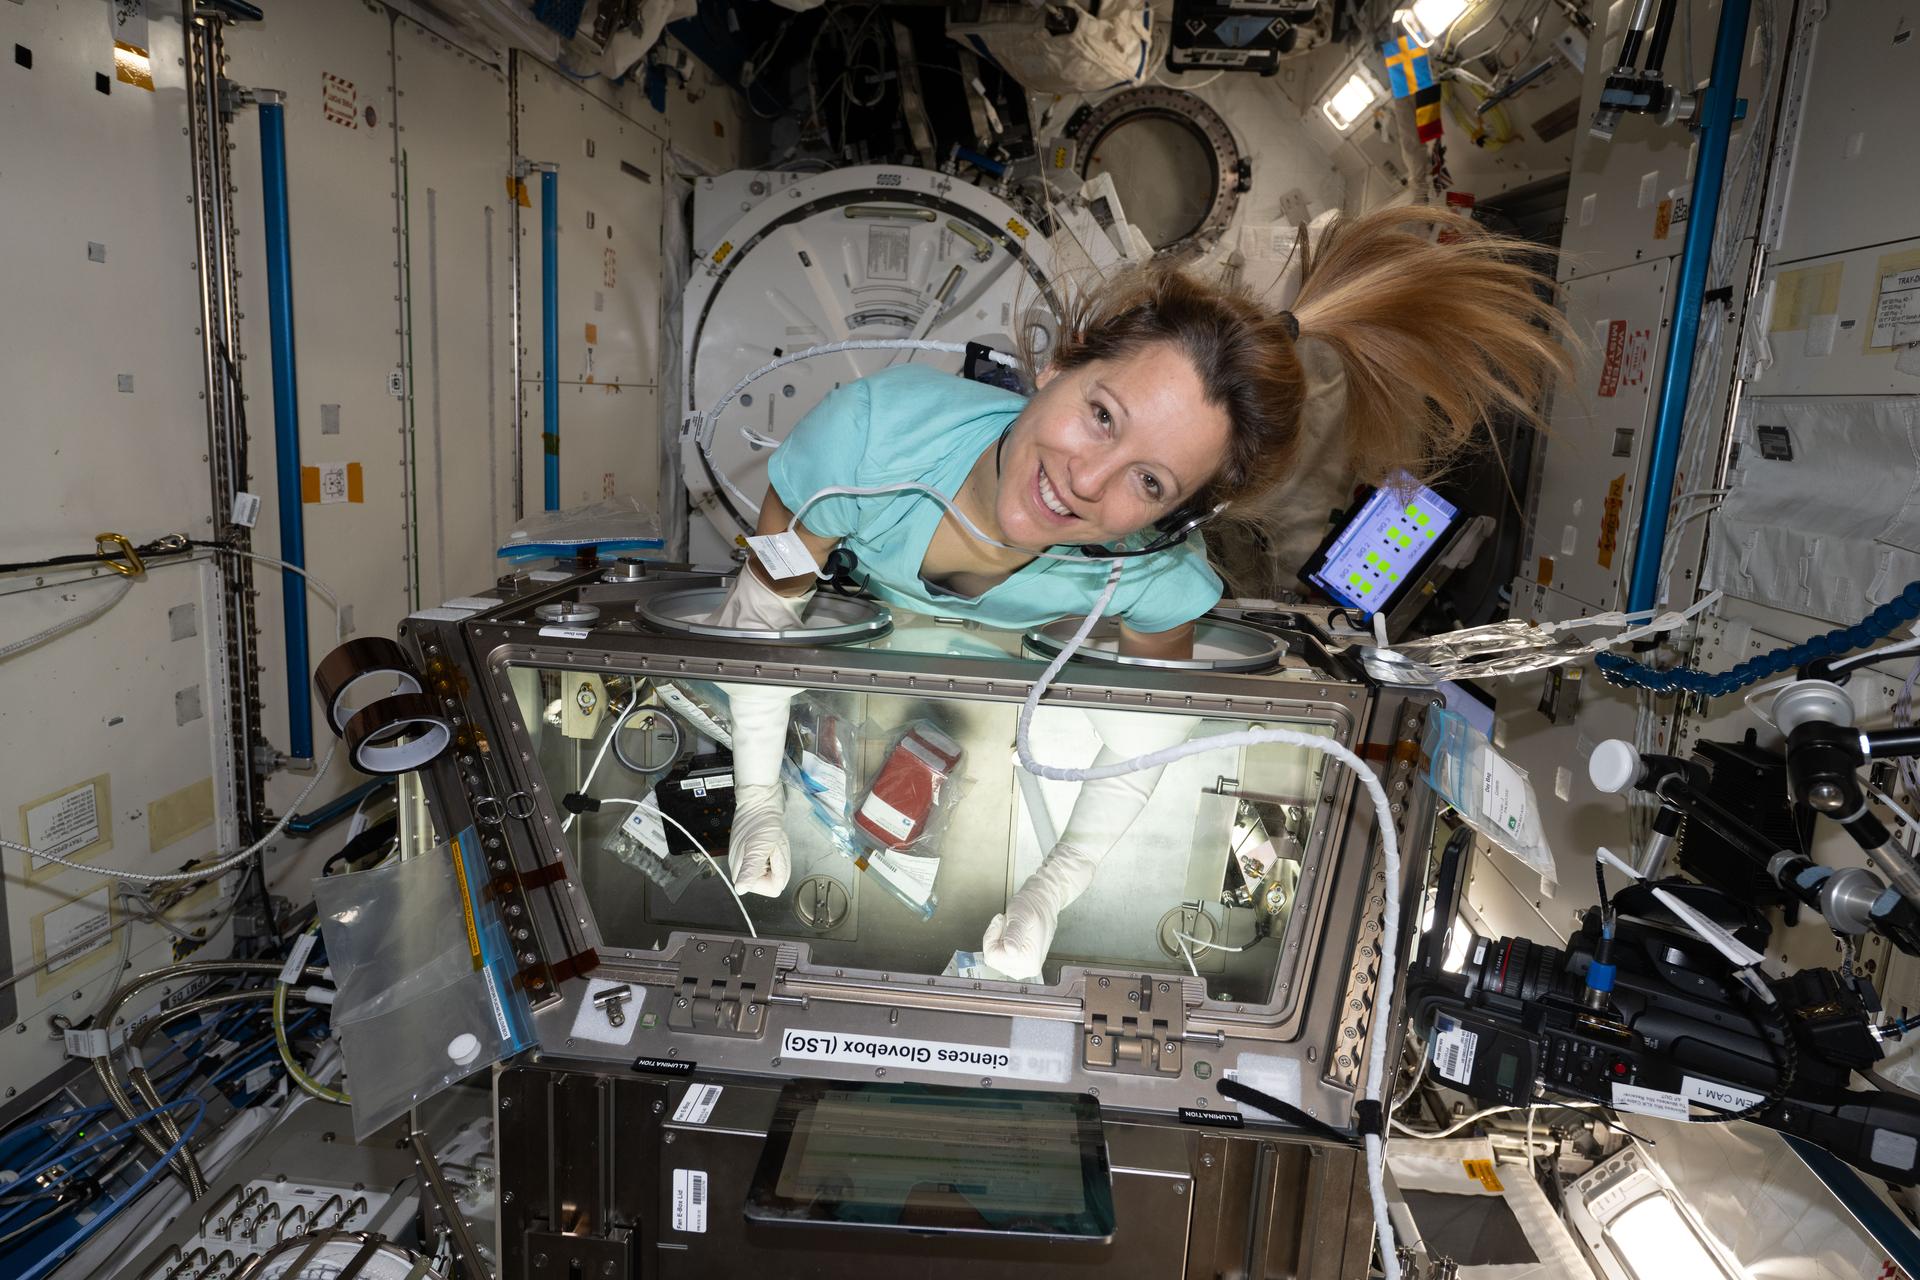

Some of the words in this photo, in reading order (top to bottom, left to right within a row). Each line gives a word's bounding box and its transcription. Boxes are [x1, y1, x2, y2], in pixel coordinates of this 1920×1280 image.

[1610, 331, 1625, 388] WATER
[785, 1032, 838, 1054] (LSG)
[843, 1040, 930, 1062] Glovebox
[639, 1060, 689, 1069] ILLUMINATION
[1705, 1089, 1733, 1103] CAM
[1185, 1111, 1238, 1120] ILLUMINATION
